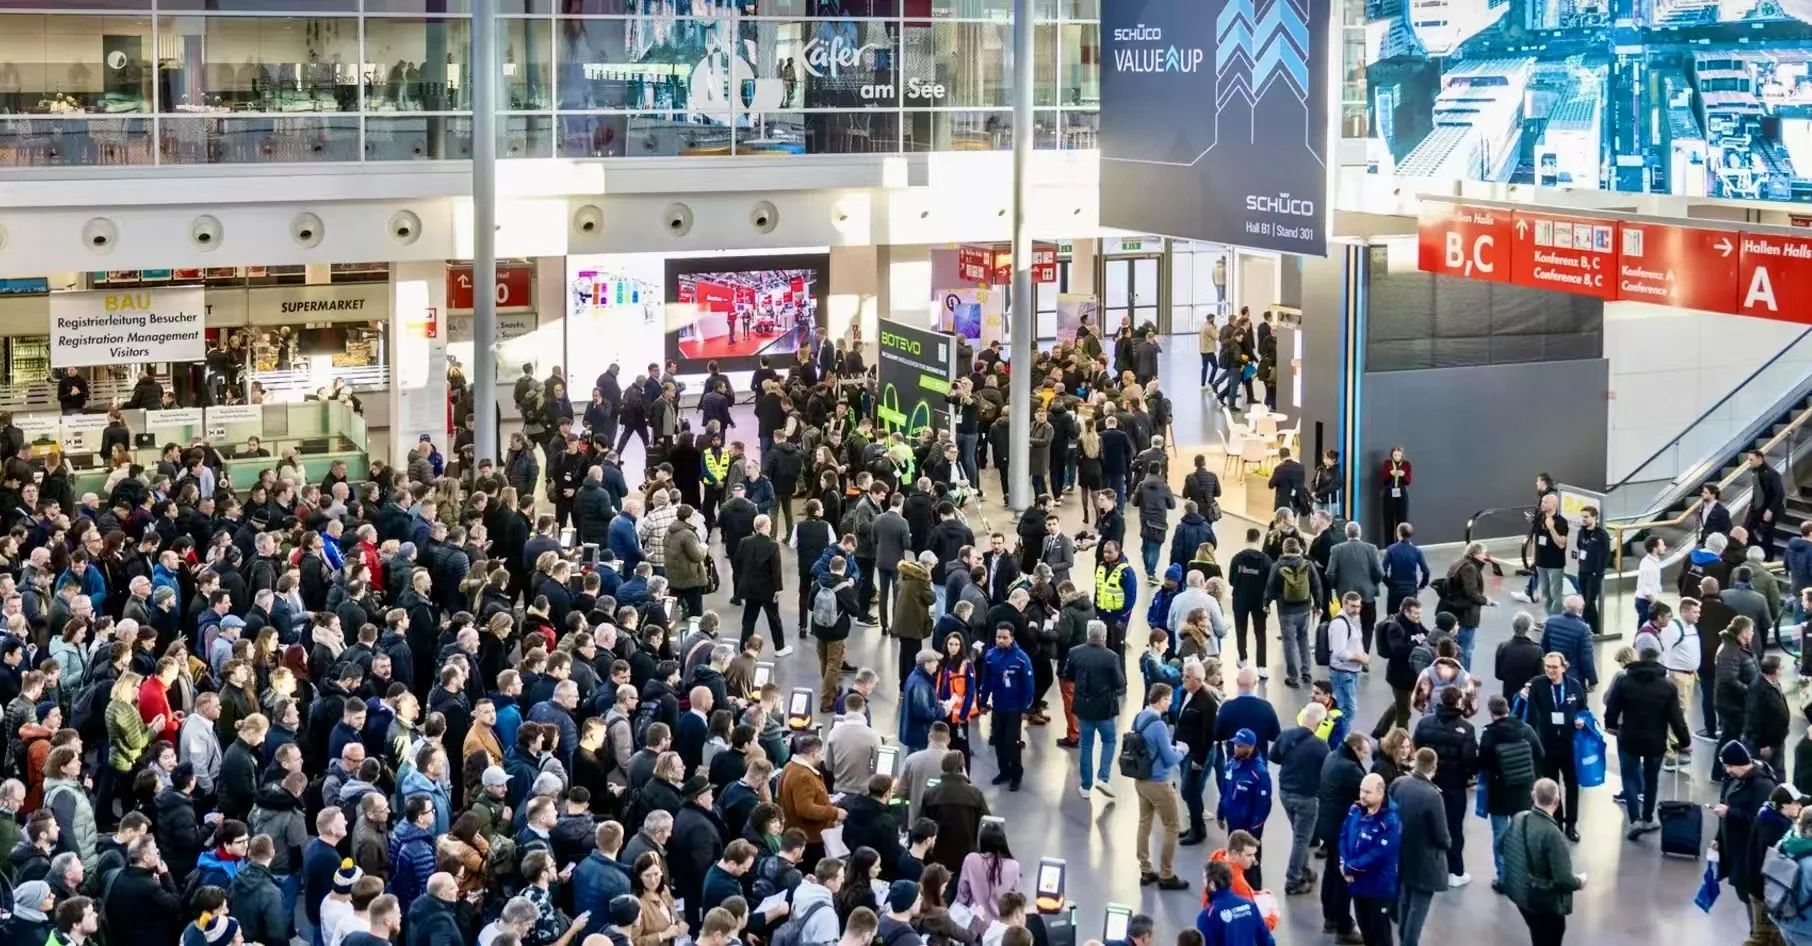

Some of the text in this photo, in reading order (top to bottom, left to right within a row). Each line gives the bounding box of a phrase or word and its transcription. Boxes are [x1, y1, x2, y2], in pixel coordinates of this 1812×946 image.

[1114, 24, 1162, 41] SCHÜCO
[799, 36, 878, 78] Käfer
[1114, 48, 1204, 73] VALUE UP
[860, 77, 945, 99] am See
[1246, 192, 1314, 217] SCHÜCO
[1246, 221, 1260, 234] Hall
[1261, 223, 1271, 235] B1
[1276, 224, 1299, 239] Stand
[1299, 227, 1314, 241] 301
[1445, 231, 1494, 277] B,C
[1744, 239, 1812, 259] Hallen Halls
[1533, 250, 1601, 270] Konferenz B, C
[1533, 268, 1603, 288] Conference B, C
[1621, 265, 1675, 281] Konferenz A
[1621, 280, 1668, 297] Conference
[1743, 266, 1779, 312] A
[104, 292, 152, 312] BAU
[281, 299, 365, 313] SUPERMARKET
[57, 312, 197, 330] Registrierleitung Besucher
[58, 331, 199, 348] Registration Management
[881, 331, 921, 355] BOTEVO
[110, 347, 150, 358] Visitors
